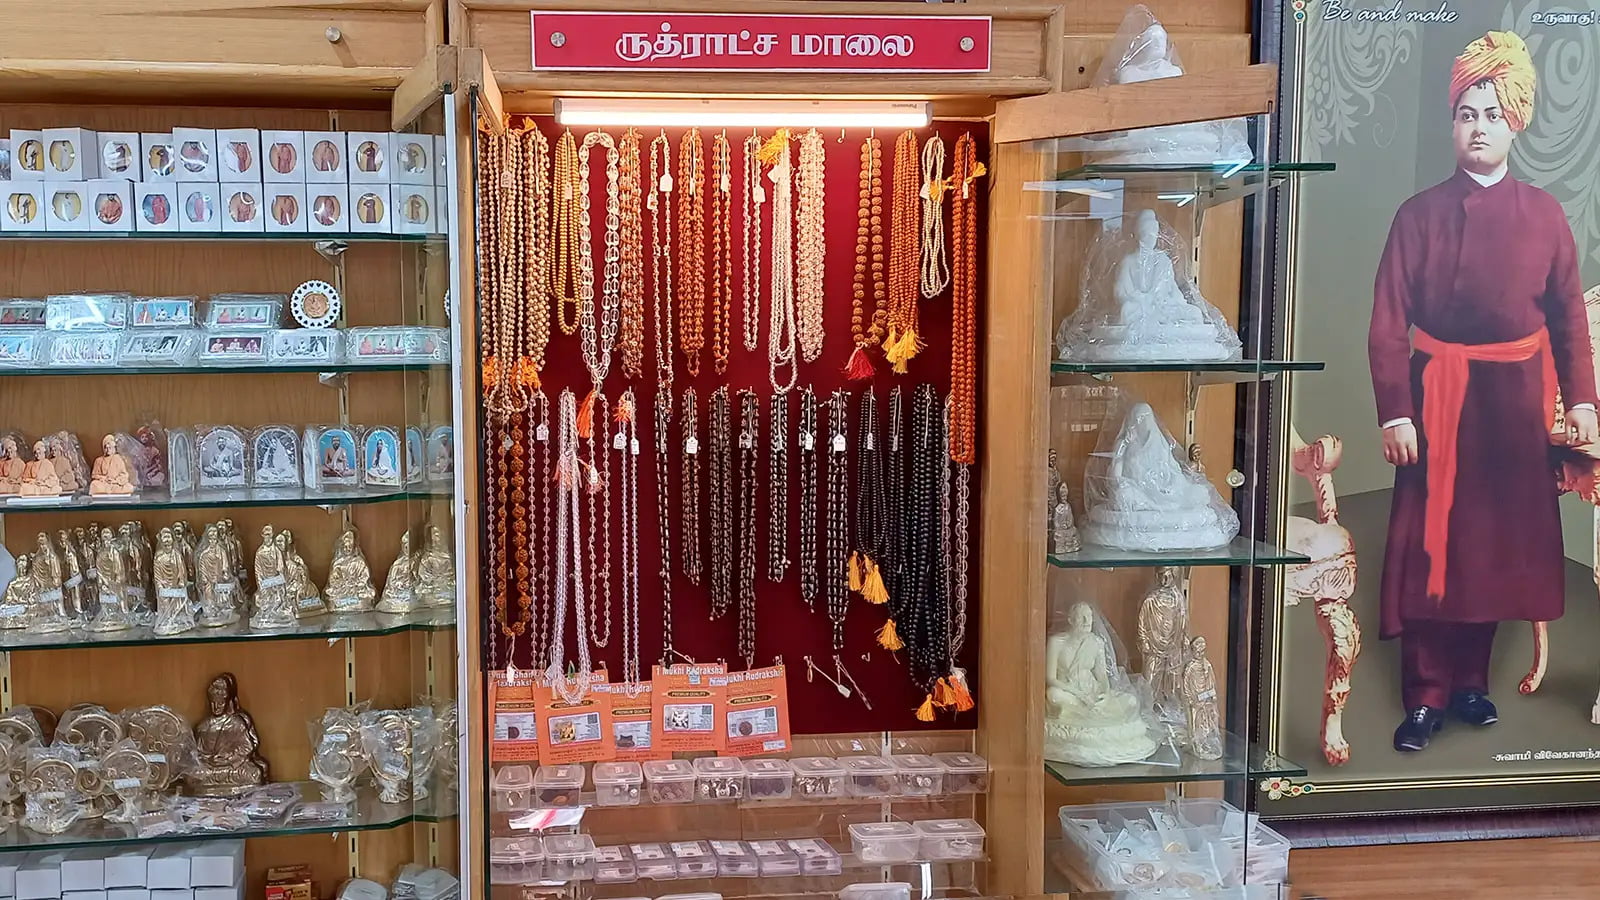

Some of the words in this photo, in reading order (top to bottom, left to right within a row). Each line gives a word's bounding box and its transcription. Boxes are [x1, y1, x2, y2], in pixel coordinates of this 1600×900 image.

[1323, 0, 1352, 20] Be
[1358, 0, 1402, 21] and
[1405, 2, 1459, 22] make
[1531, 10, 1595, 26] உருவாகு!
[615, 22, 779, 62] ருத்ராட்ச
[791, 34, 914, 57] மாலை
[686, 665, 724, 675] Rdraksha
[726, 675, 744, 684] ukhi
